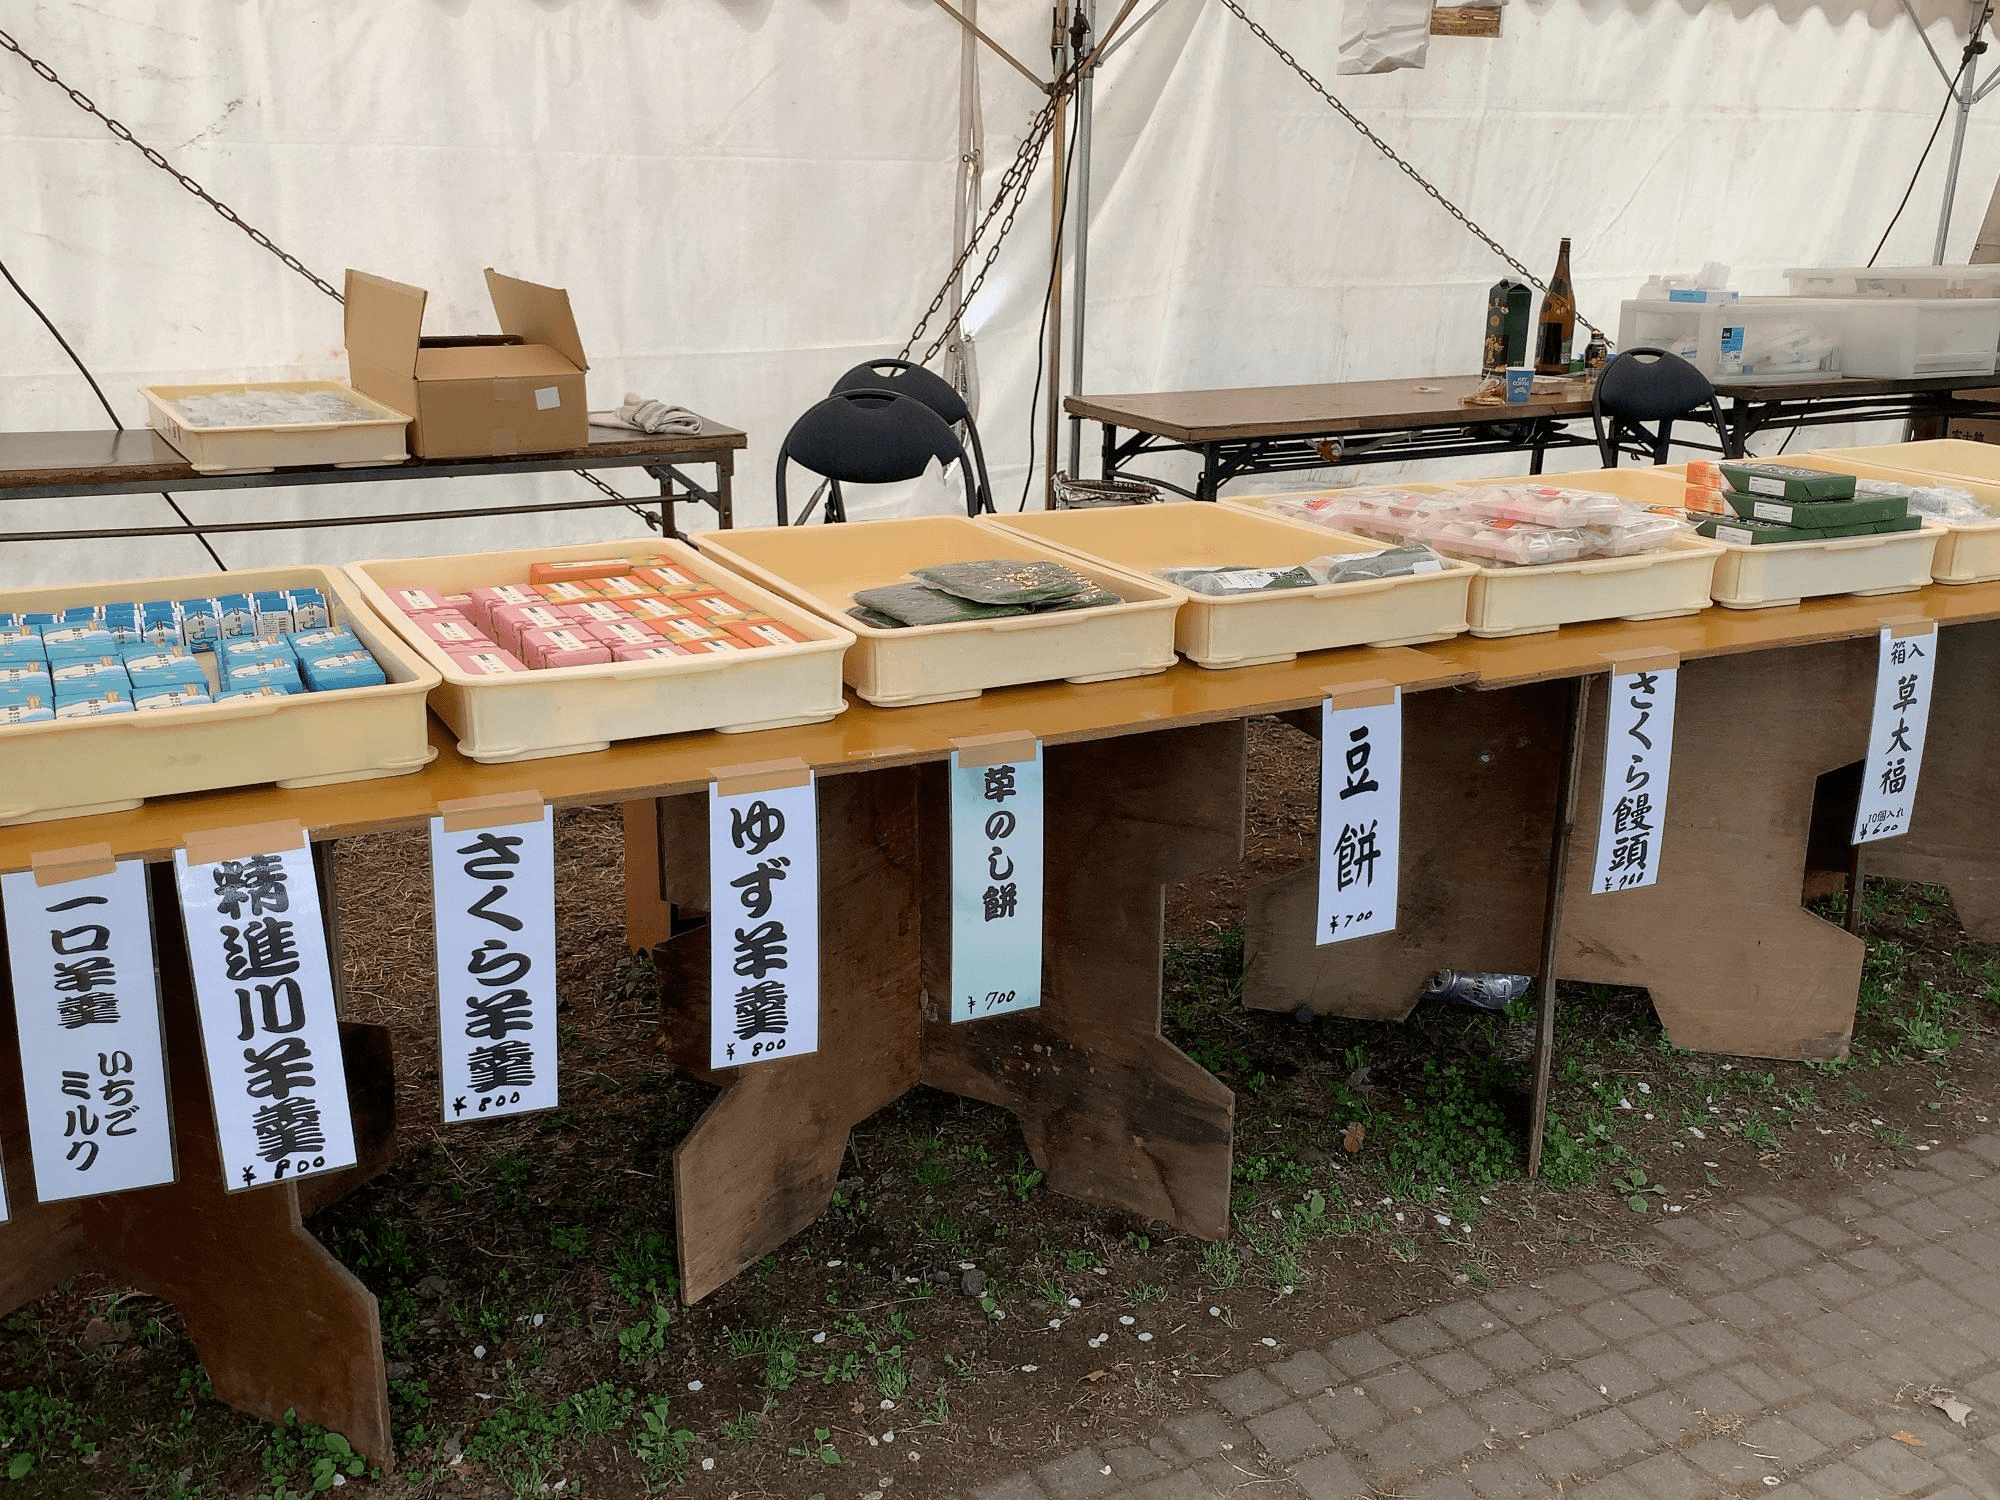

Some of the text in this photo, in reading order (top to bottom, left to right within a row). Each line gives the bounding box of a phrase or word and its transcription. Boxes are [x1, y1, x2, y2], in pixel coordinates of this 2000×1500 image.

[1891, 641, 1924, 665] 箱入
[1609, 672, 1660, 872] さくら饅頭
[1880, 674, 1920, 796] 草大福
[983, 765, 1017, 922] 草のし餅
[1334, 726, 1381, 892] 豆餅
[1867, 808, 1903, 824] 10個入れ
[46, 896, 121, 1029] 一口羊羹
[457, 833, 535, 1093] さくら羊羹
[730, 801, 790, 1040] ゆず羊羹
[213, 853, 326, 1162] 精進川羊羹
[62, 1071, 100, 1171] ミルク
[96, 1051, 139, 1136] いちご
